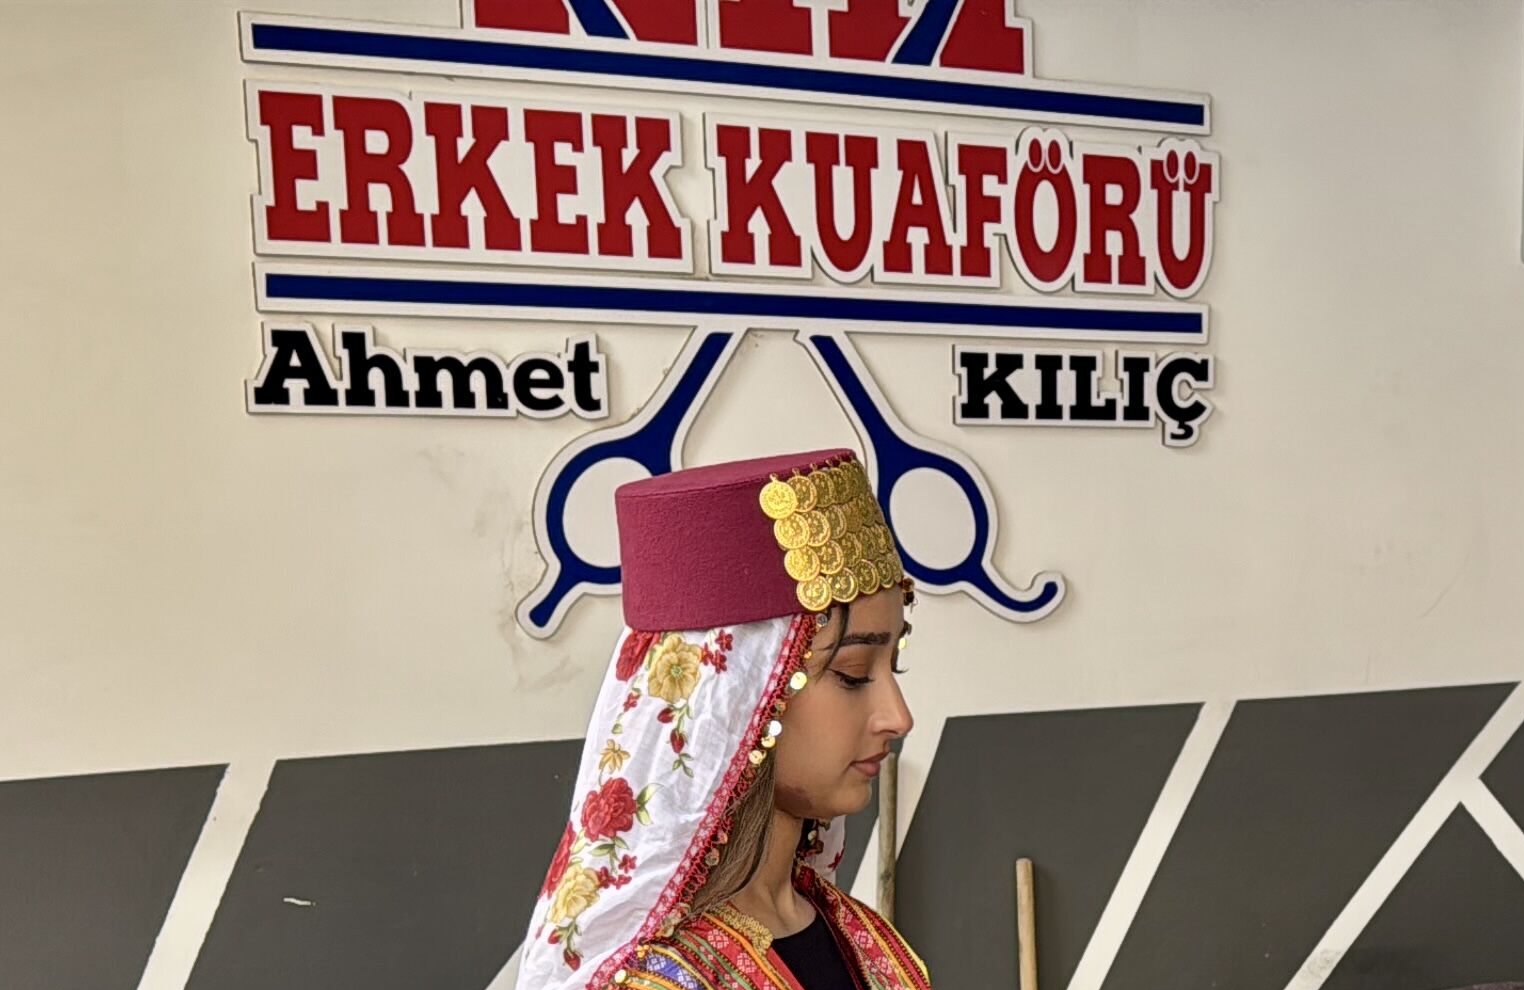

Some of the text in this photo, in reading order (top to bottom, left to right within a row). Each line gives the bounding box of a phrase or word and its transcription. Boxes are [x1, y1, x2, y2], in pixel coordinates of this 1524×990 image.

[257, 89, 1213, 290] ERKEK KUAFÖRÜ
[252, 328, 1210, 440] Ahmet KILIÇ
